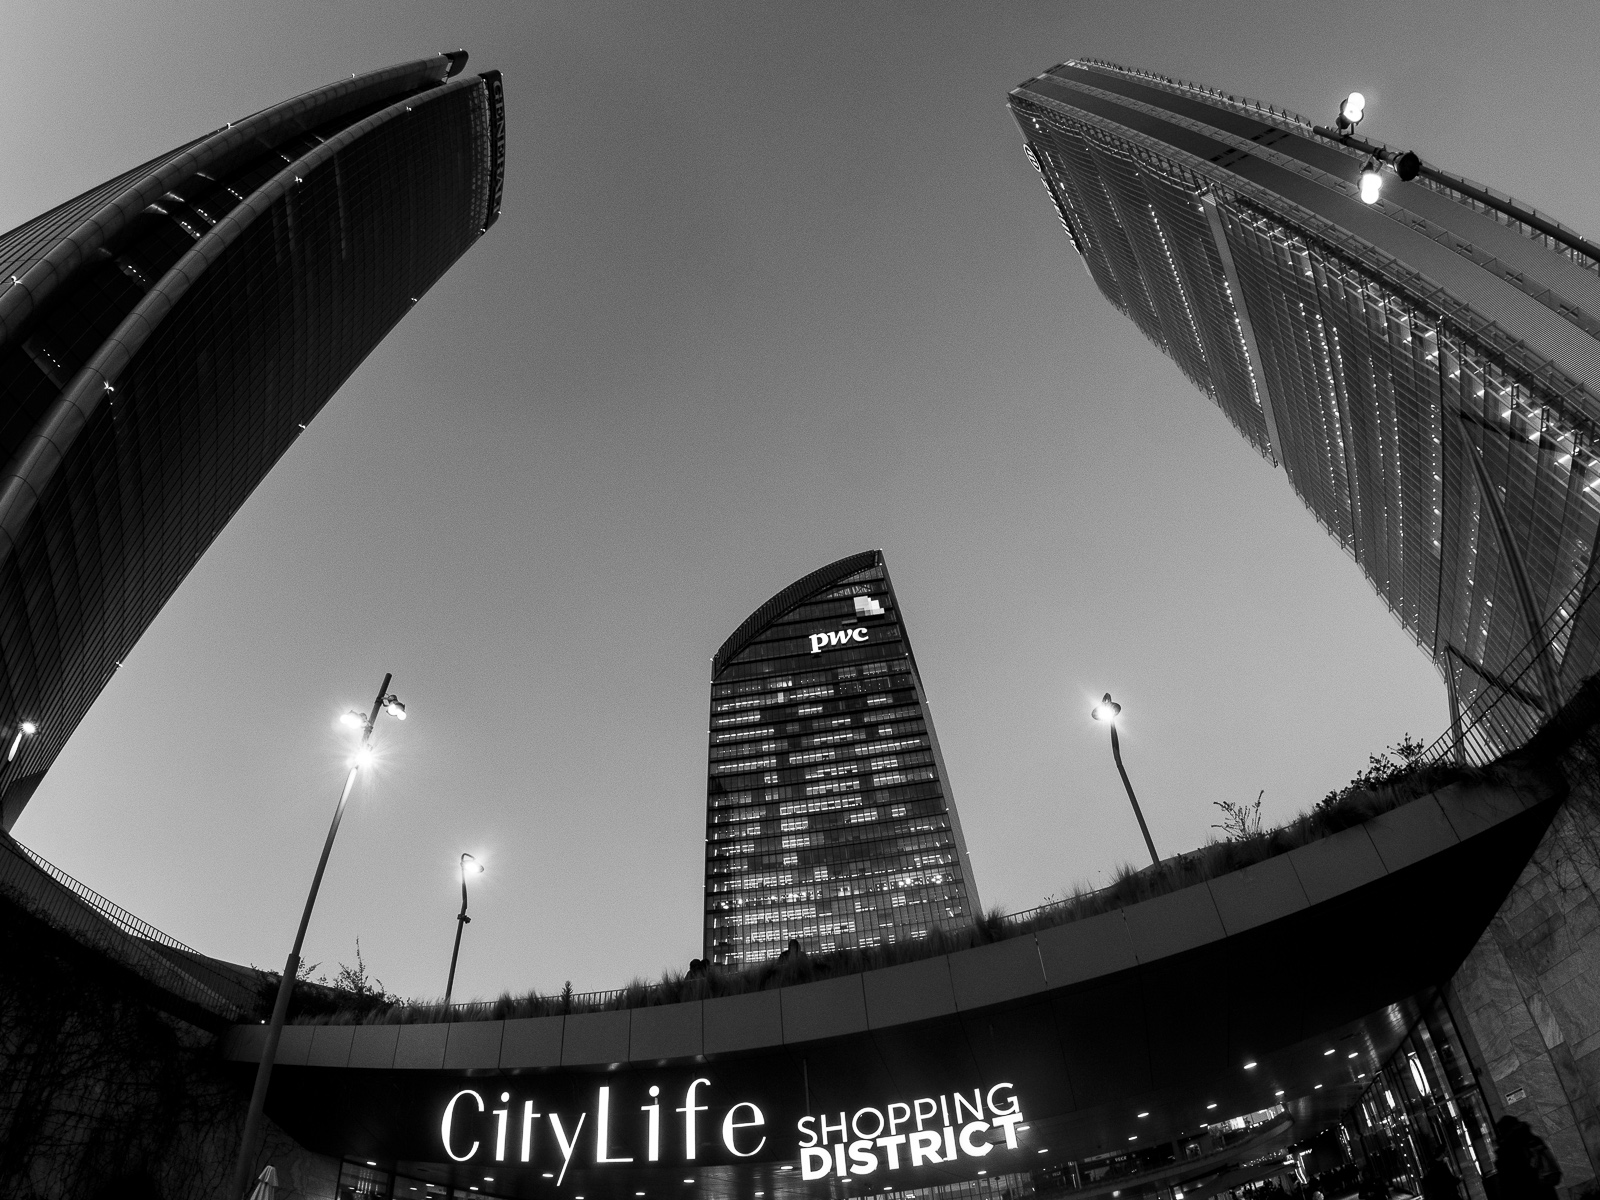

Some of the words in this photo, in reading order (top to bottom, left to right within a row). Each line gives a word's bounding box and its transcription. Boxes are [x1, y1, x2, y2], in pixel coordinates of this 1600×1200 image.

[493, 80, 505, 213] GENERALI
[1041, 178, 1081, 255] Allianz
[808, 627, 869, 654] pwc
[440, 1078, 767, 1187] CityLife
[797, 1083, 1020, 1149] SHOPPING
[800, 1112, 1025, 1181] DISTRICT
